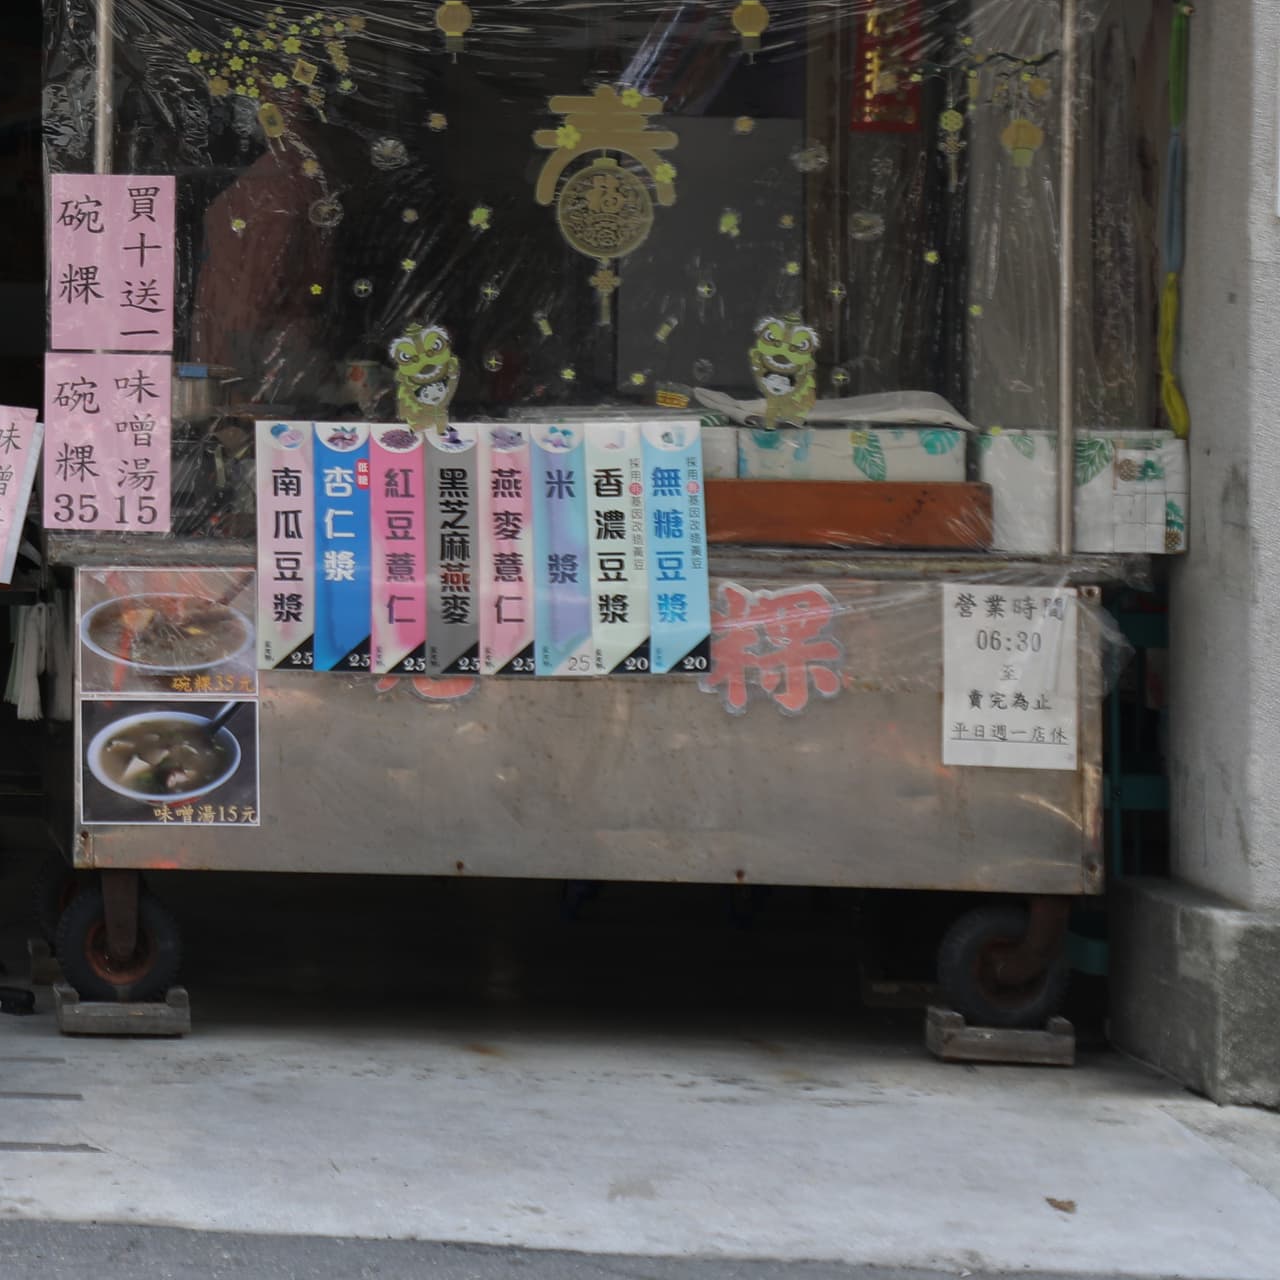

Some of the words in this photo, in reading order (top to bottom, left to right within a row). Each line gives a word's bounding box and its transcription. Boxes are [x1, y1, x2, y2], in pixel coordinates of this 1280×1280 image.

[56, 194, 104, 305] 碗粿
[120, 186, 166, 337] 買十送一
[52, 376, 100, 483] 碗粿
[113, 369, 160, 492] 味噌湯
[54, 493, 99, 524] 35
[116, 496, 158, 525] 15
[323, 467, 357, 583] 杏仁漿
[546, 468, 579, 585] 米漿
[271, 467, 305, 624] 南瓜豆漿
[385, 468, 416, 624] 紅豆薏仁
[439, 467, 471, 625] 黑芝麻燕麥
[491, 468, 525, 624] 燕麥薏仁
[593, 468, 630, 624] 香濃豆漿
[652, 466, 689, 624] 無糖豆漿
[955, 593, 1064, 620] 營業時間
[977, 629, 1042, 652] 06:30
[291, 651, 313, 665] 25
[349, 654, 371, 667] 25
[403, 657, 426, 671] 25
[458, 657, 480, 670] 25
[512, 657, 535, 670] 25
[567, 656, 590, 671] 25
[625, 657, 649, 670] 20
[683, 656, 707, 670] 20
[1000, 664, 1019, 681] 至
[968, 689, 1052, 711] 賣完為止
